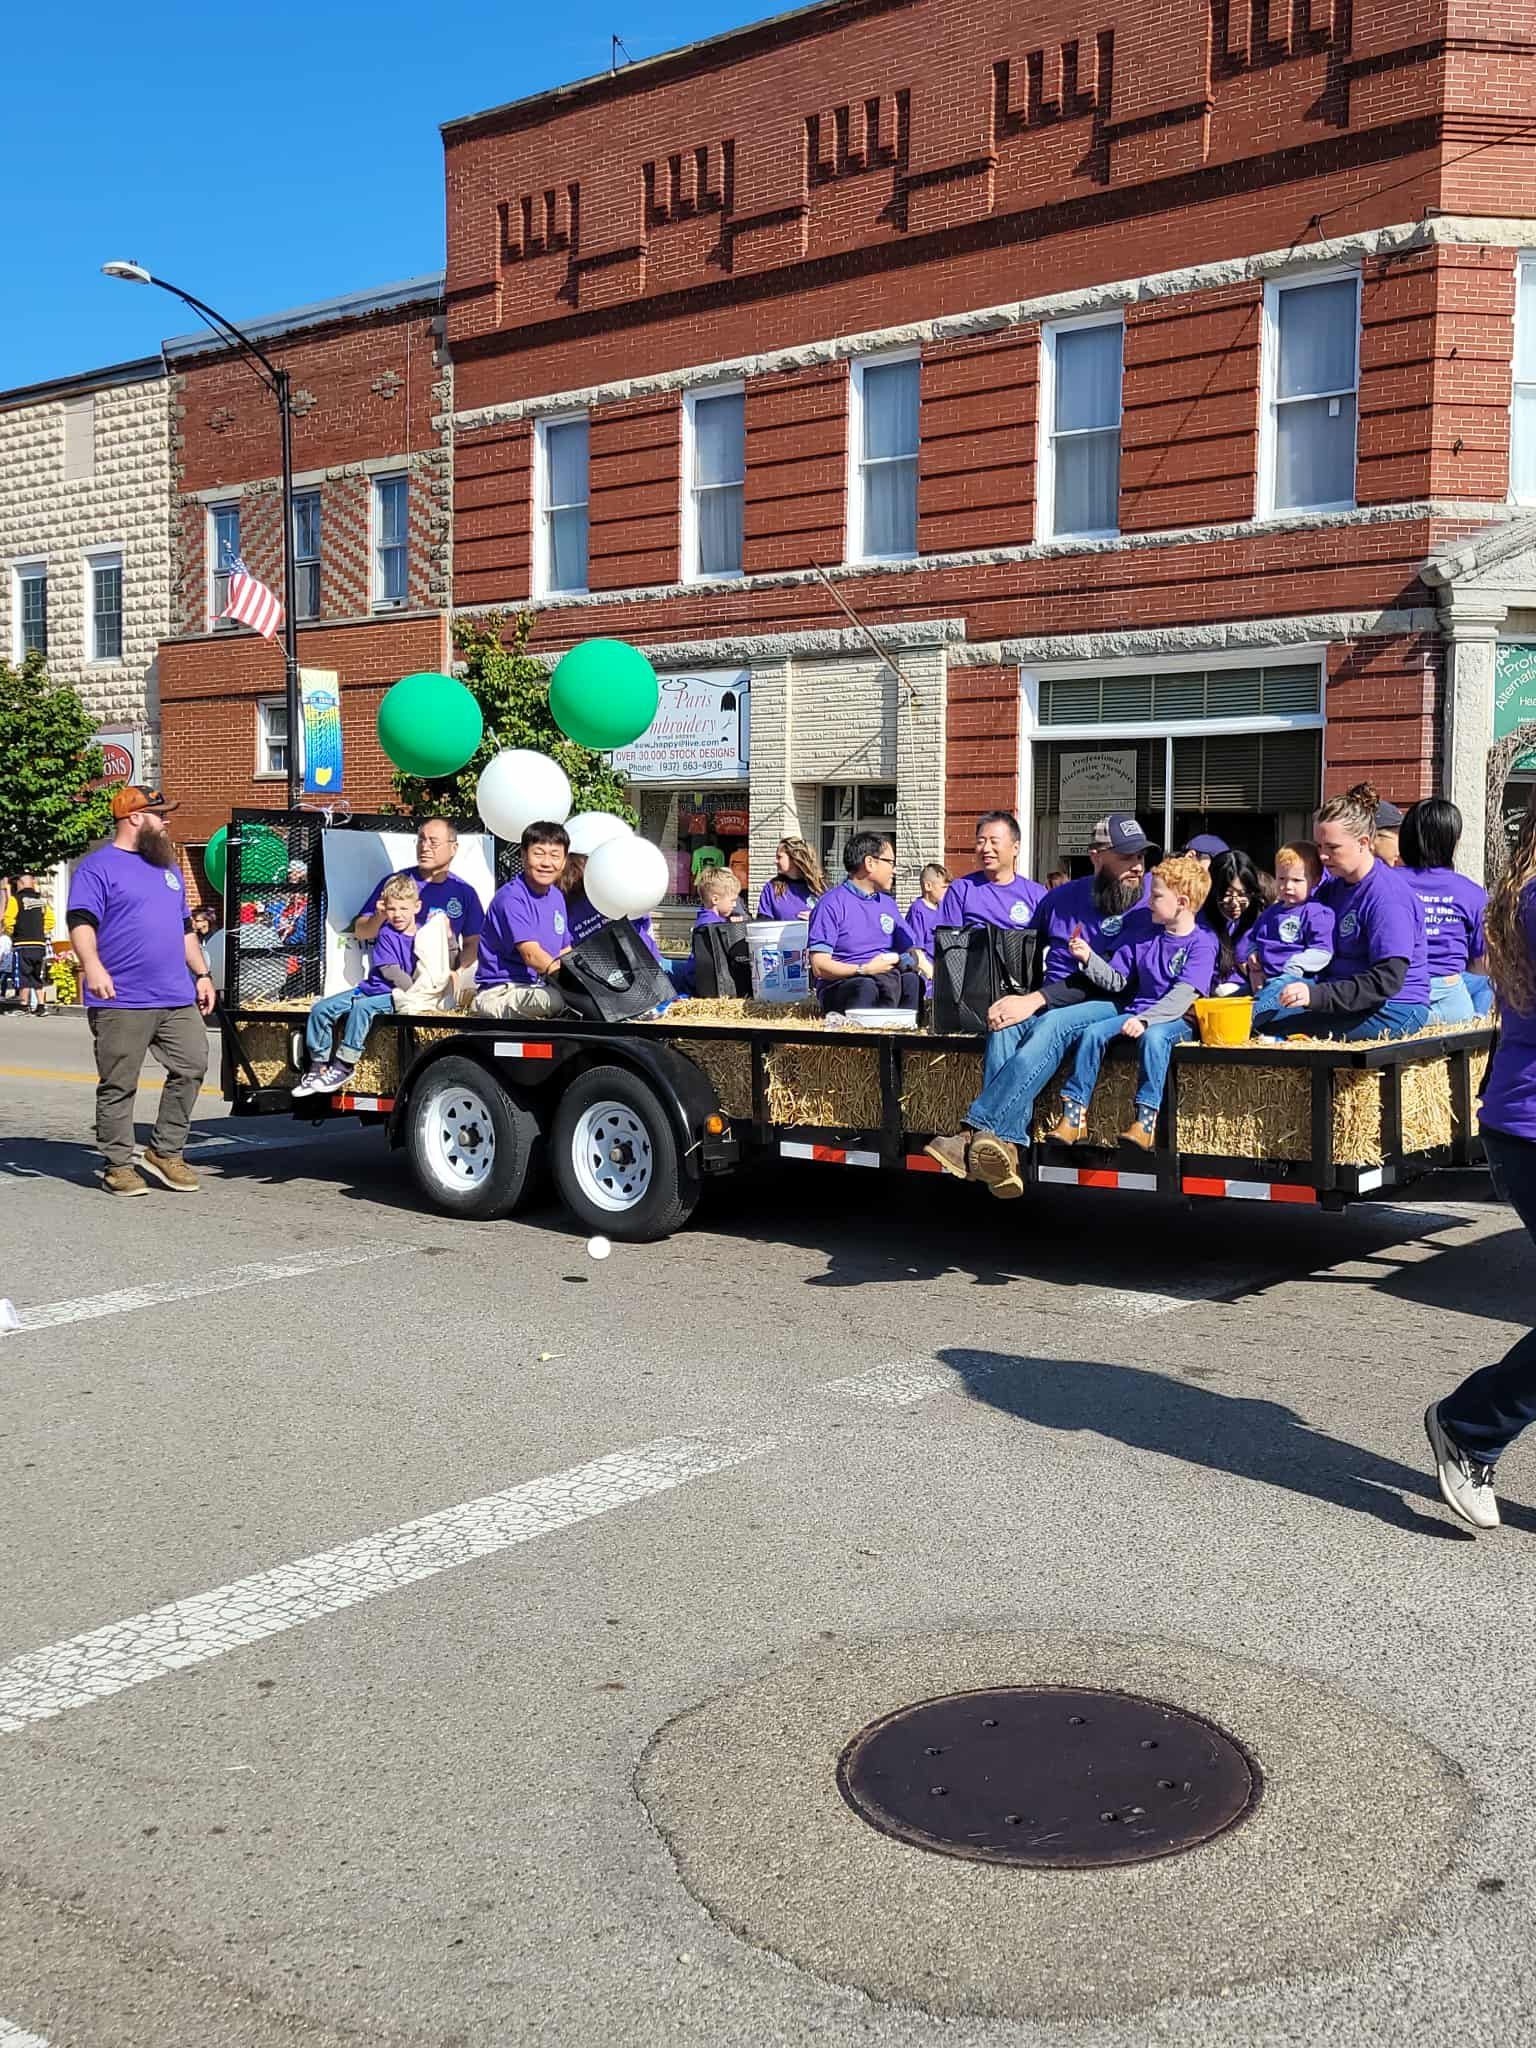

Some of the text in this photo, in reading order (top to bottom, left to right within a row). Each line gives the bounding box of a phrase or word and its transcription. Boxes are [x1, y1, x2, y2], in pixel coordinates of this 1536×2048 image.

[1504, 653, 1536, 677] Prof
[675, 689, 712, 709] Paris
[650, 713, 716, 734] mbroidery
[616, 751, 636, 761] OVER
[670, 749, 696, 760] STOCK
[700, 747, 735, 759] DESIGNS
[659, 761, 680, 772] (937)
[884, 803, 897, 815] 10
